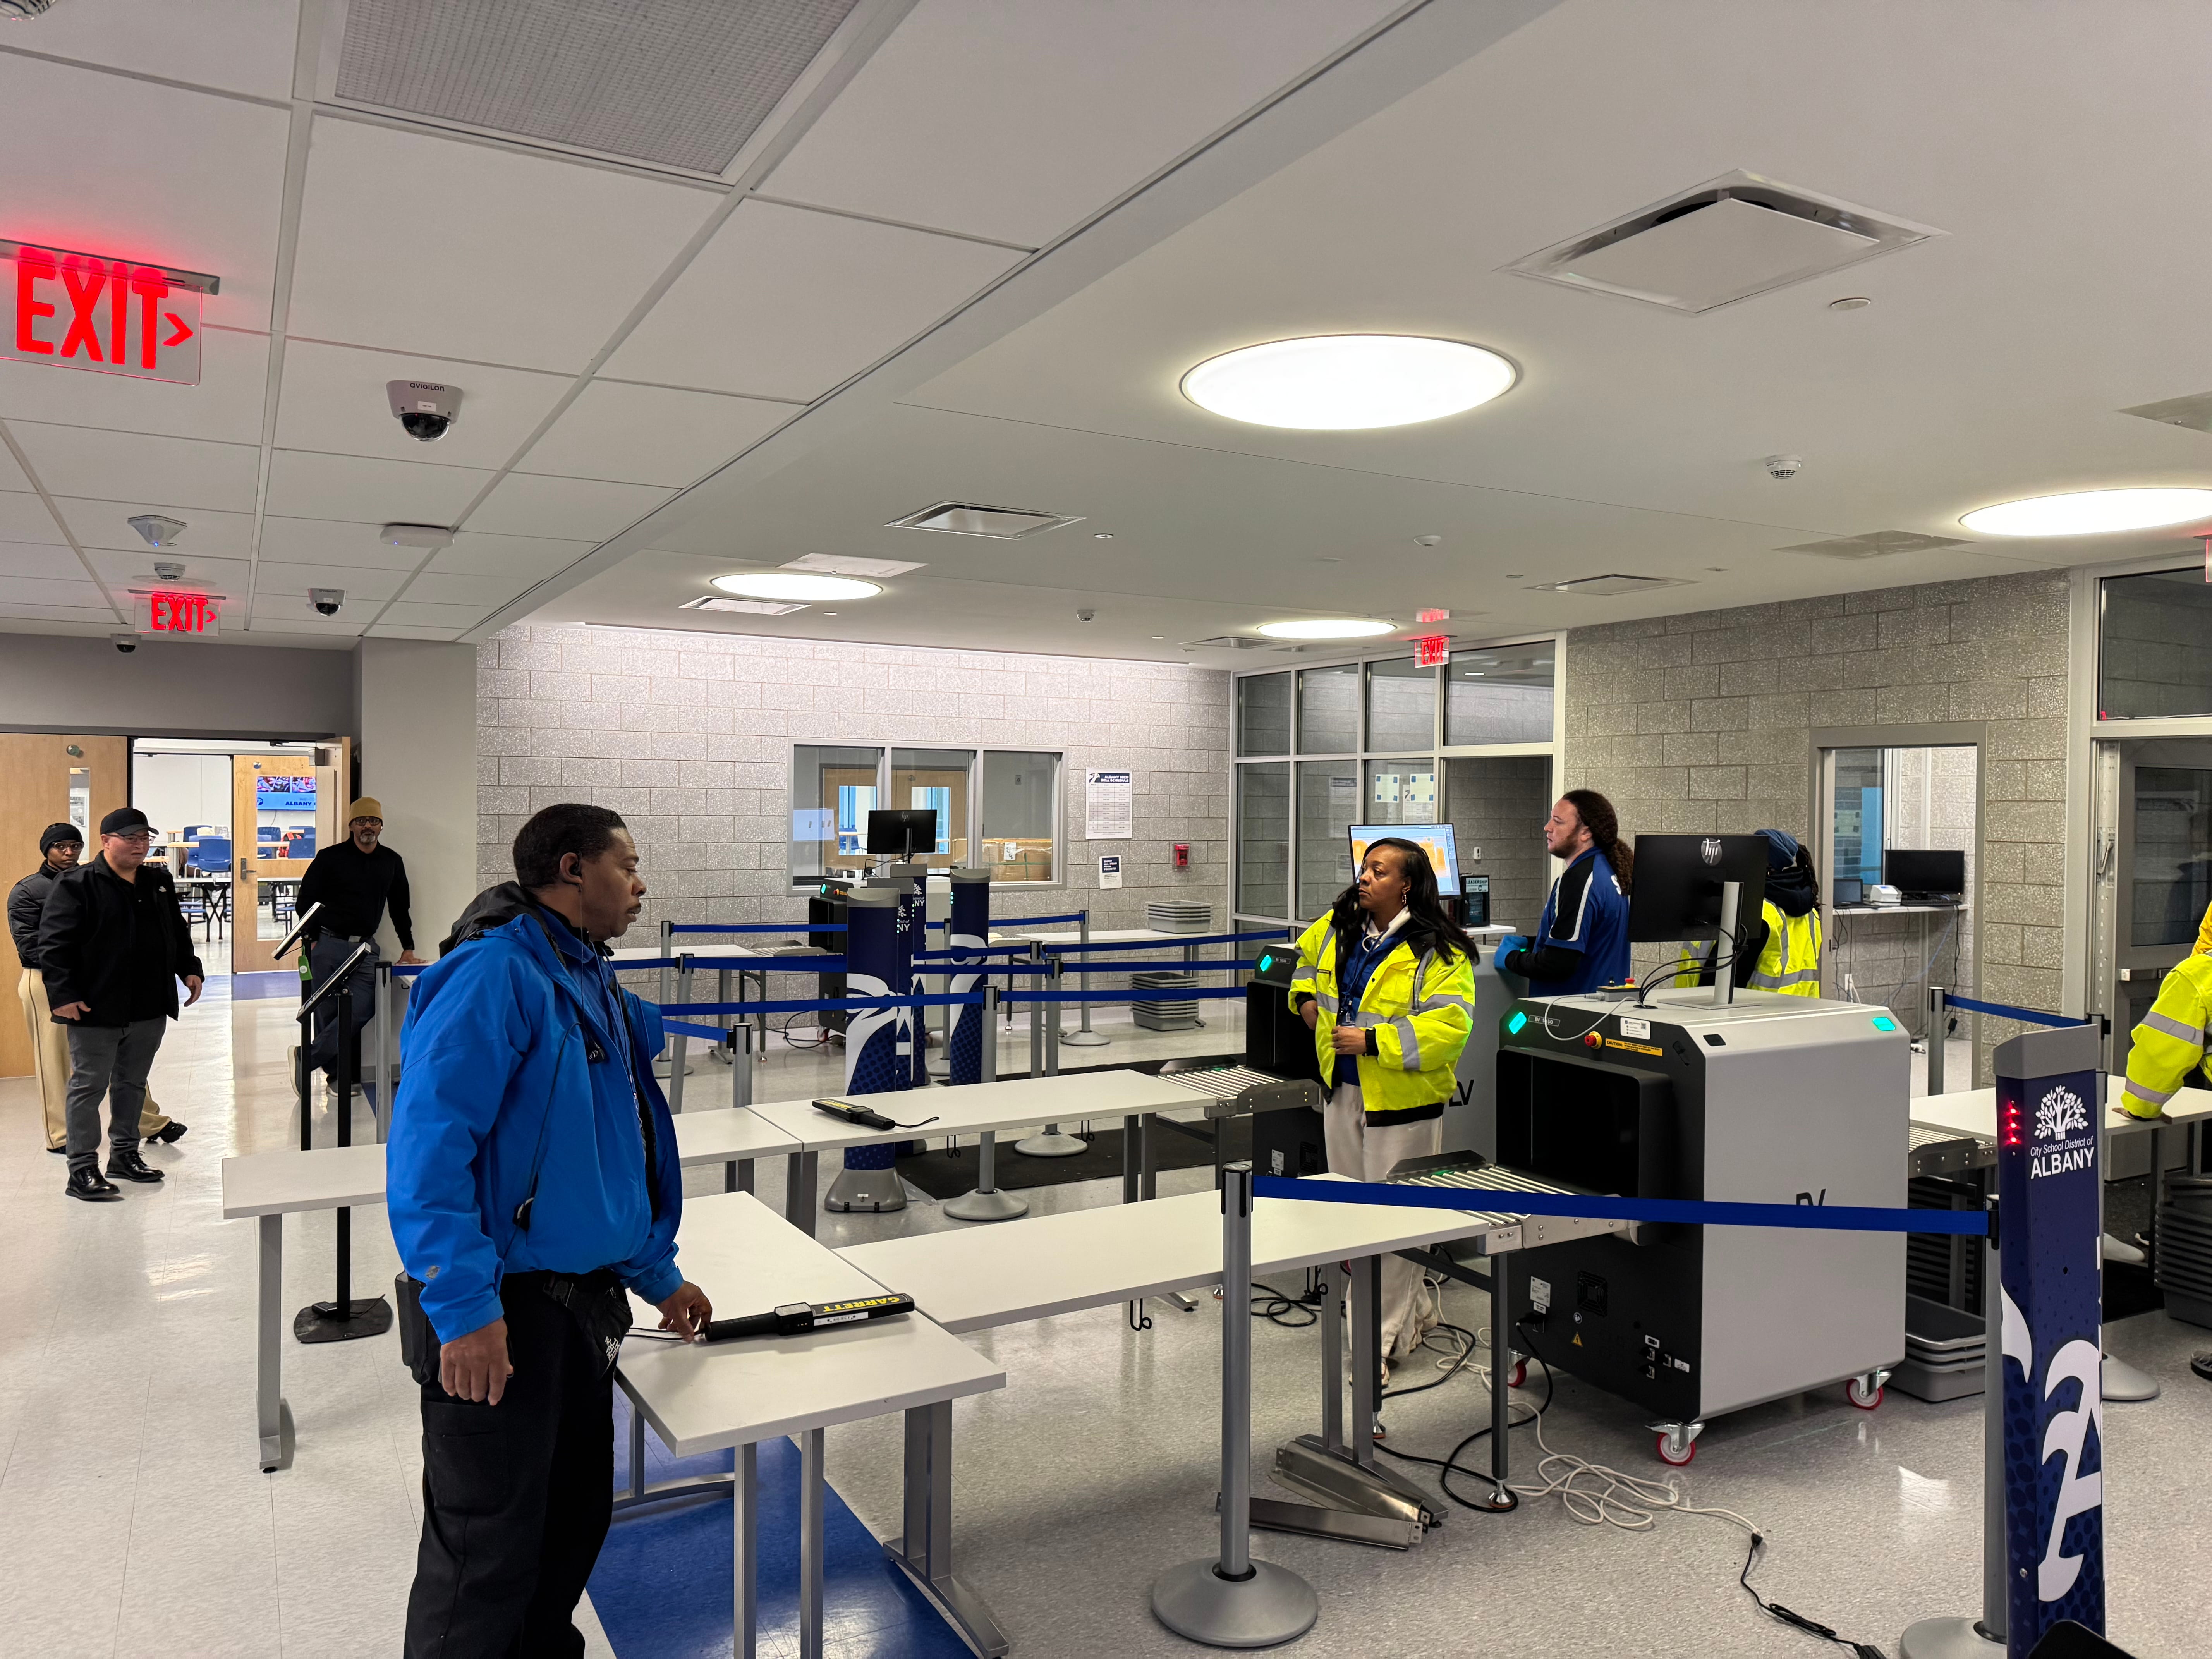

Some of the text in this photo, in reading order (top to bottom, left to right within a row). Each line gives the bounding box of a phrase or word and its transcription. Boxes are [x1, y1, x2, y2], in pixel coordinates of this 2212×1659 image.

[16, 261, 168, 369] EXIT
[151, 596, 208, 632] EXIT
[1422, 639, 1444, 665] EXIT
[1705, 839, 1718, 864] hp
[2030, 1135, 2094, 1158] City School District of
[2031, 1147, 2095, 1180] ALBANY
[823, 1297, 900, 1312] GARRETT
